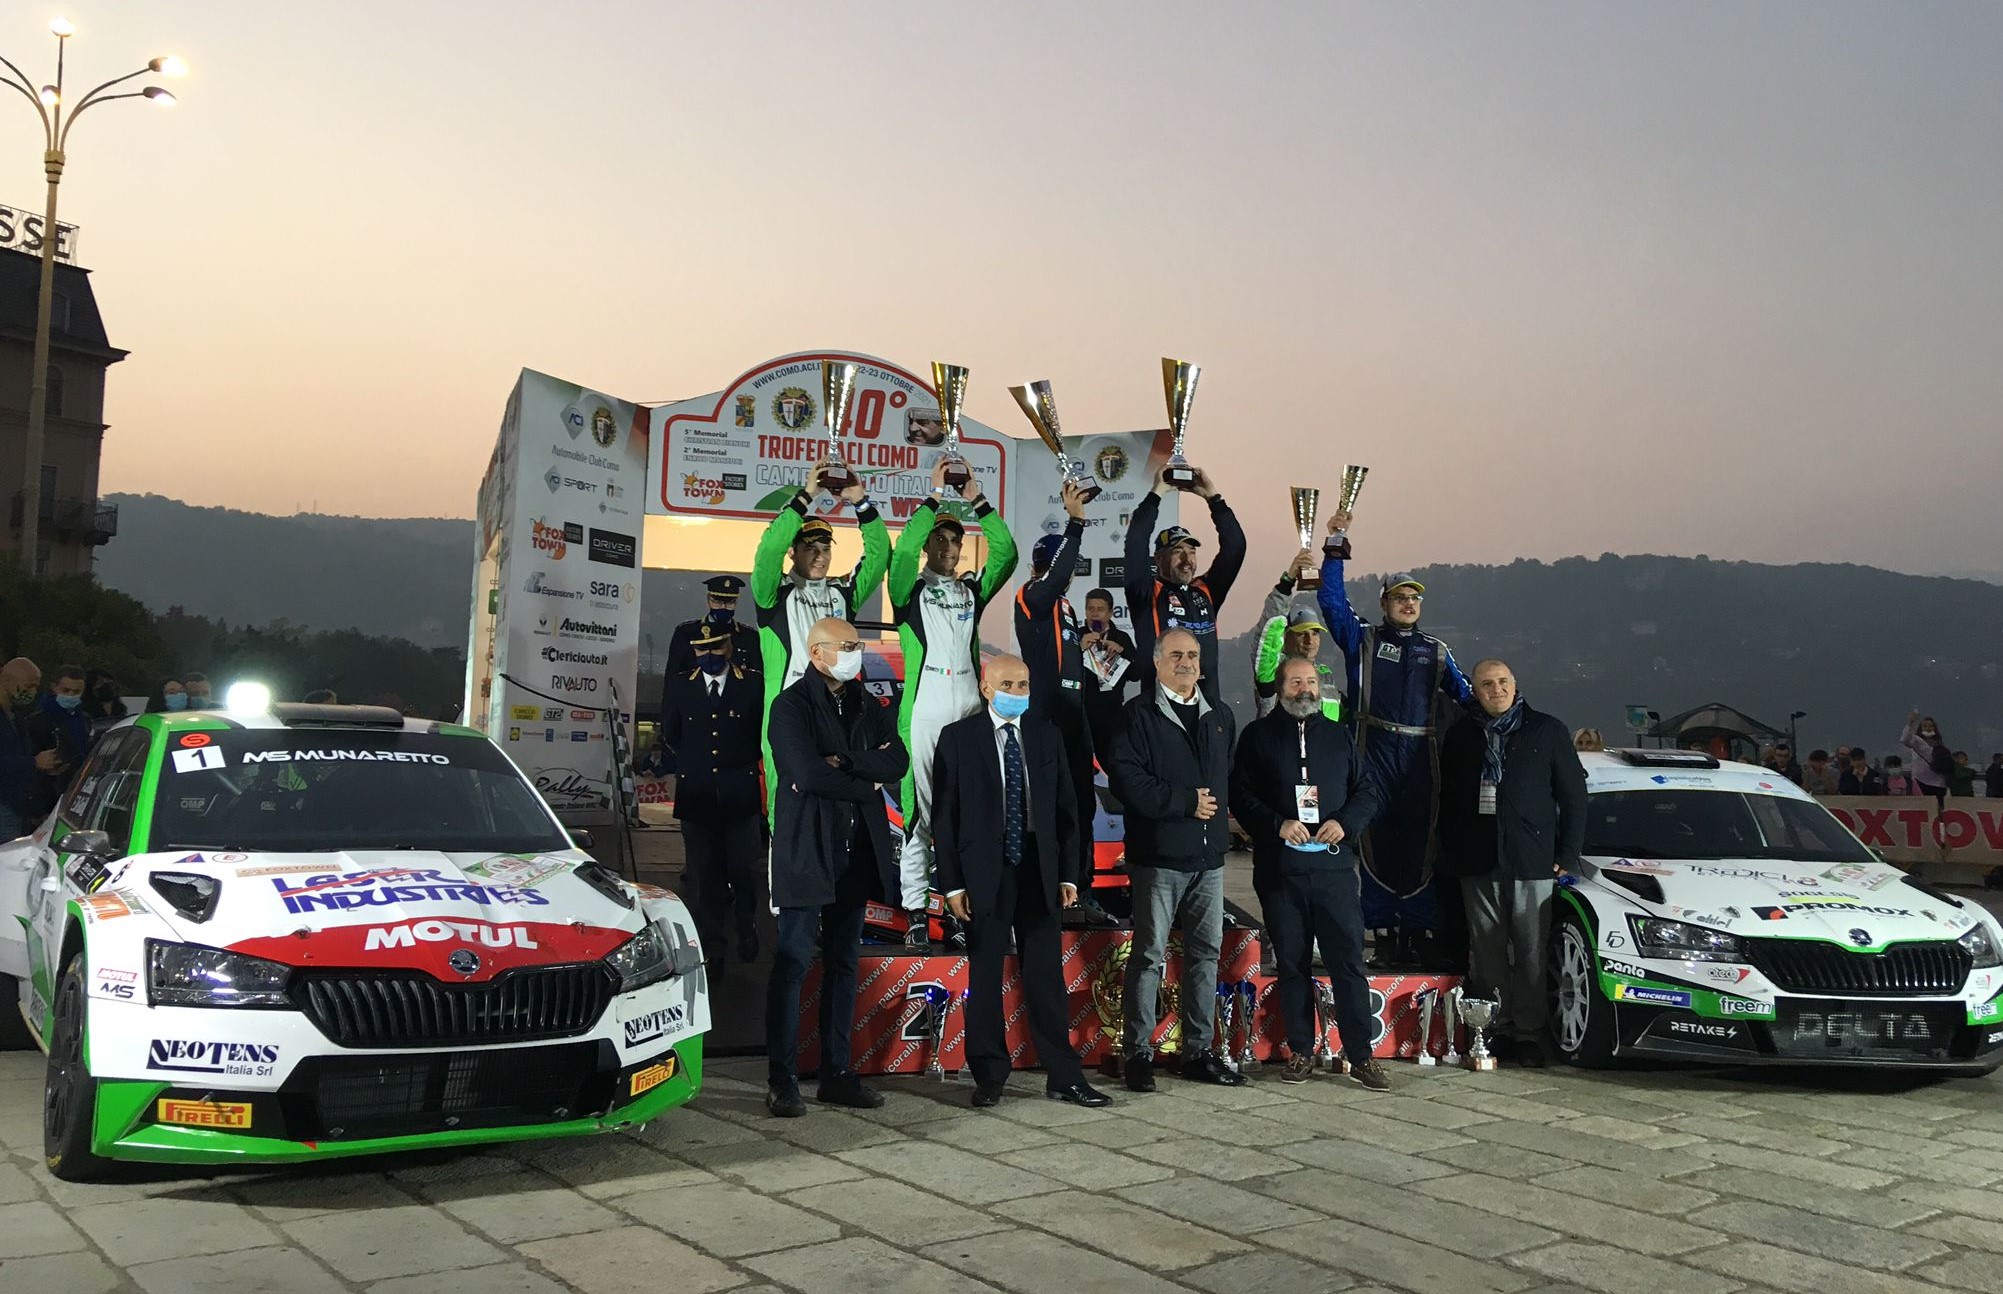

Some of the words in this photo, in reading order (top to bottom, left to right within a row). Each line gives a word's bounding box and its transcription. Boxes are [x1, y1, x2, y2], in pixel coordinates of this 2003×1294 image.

[880, 371, 915, 394] OTTOBRE
[694, 429, 728, 438] Memorial
[551, 444, 588, 463] Automobile
[588, 454, 602, 468] Club
[603, 458, 620, 472] Como
[692, 447, 727, 456] Memorial
[867, 445, 918, 470] COMO
[563, 477, 598, 493] SPORT
[699, 478, 725, 489] FOX
[683, 488, 725, 498] TOWN
[1112, 491, 1135, 501] Como
[1065, 518, 1107, 528] SORT
[546, 526, 568, 542] FOX
[531, 536, 566, 552] TOWN
[593, 538, 632, 554] DRIVER
[1050, 537, 1069, 567] HYUNDAI
[1105, 565, 1158, 575] DRR
[541, 586, 574, 599] Espansione
[575, 591, 585, 600] TV
[590, 581, 619, 598] sara
[560, 617, 617, 637] Autovittani
[548, 647, 608, 666] Clericiauto.it
[552, 675, 597, 692] RIVAUTO
[872, 682, 885, 696] 3
[190, 749, 208, 768] 1
[242, 750, 292, 764] MS
[294, 750, 450, 766] MUNARETTO
[636, 781, 668, 797] FOX
[180, 800, 206, 809] OMP
[264, 864, 338, 872] FOXTOWN
[271, 868, 466, 893] LASER
[282, 884, 550, 914] INDUSTRIES
[865, 907, 894, 921] OMP
[1781, 902, 1915, 918] PROMOX
[364, 920, 539, 951] MOTUL
[1603, 960, 1646, 978] panta
[1636, 991, 1683, 1003] MICHELIN
[901, 981, 950, 1041] 2
[1719, 996, 1773, 1015] freem
[624, 1004, 683, 1043] NEOTENS
[663, 1025, 676, 1037] Italia
[1670, 1021, 1726, 1036] RETAKE
[1797, 1013, 1931, 1040] DELTA
[147, 1039, 279, 1070] NEOTENS
[225, 1064, 253, 1076] Italia
[256, 1065, 273, 1077] Srl
[166, 1102, 245, 1126] PIRELLI
